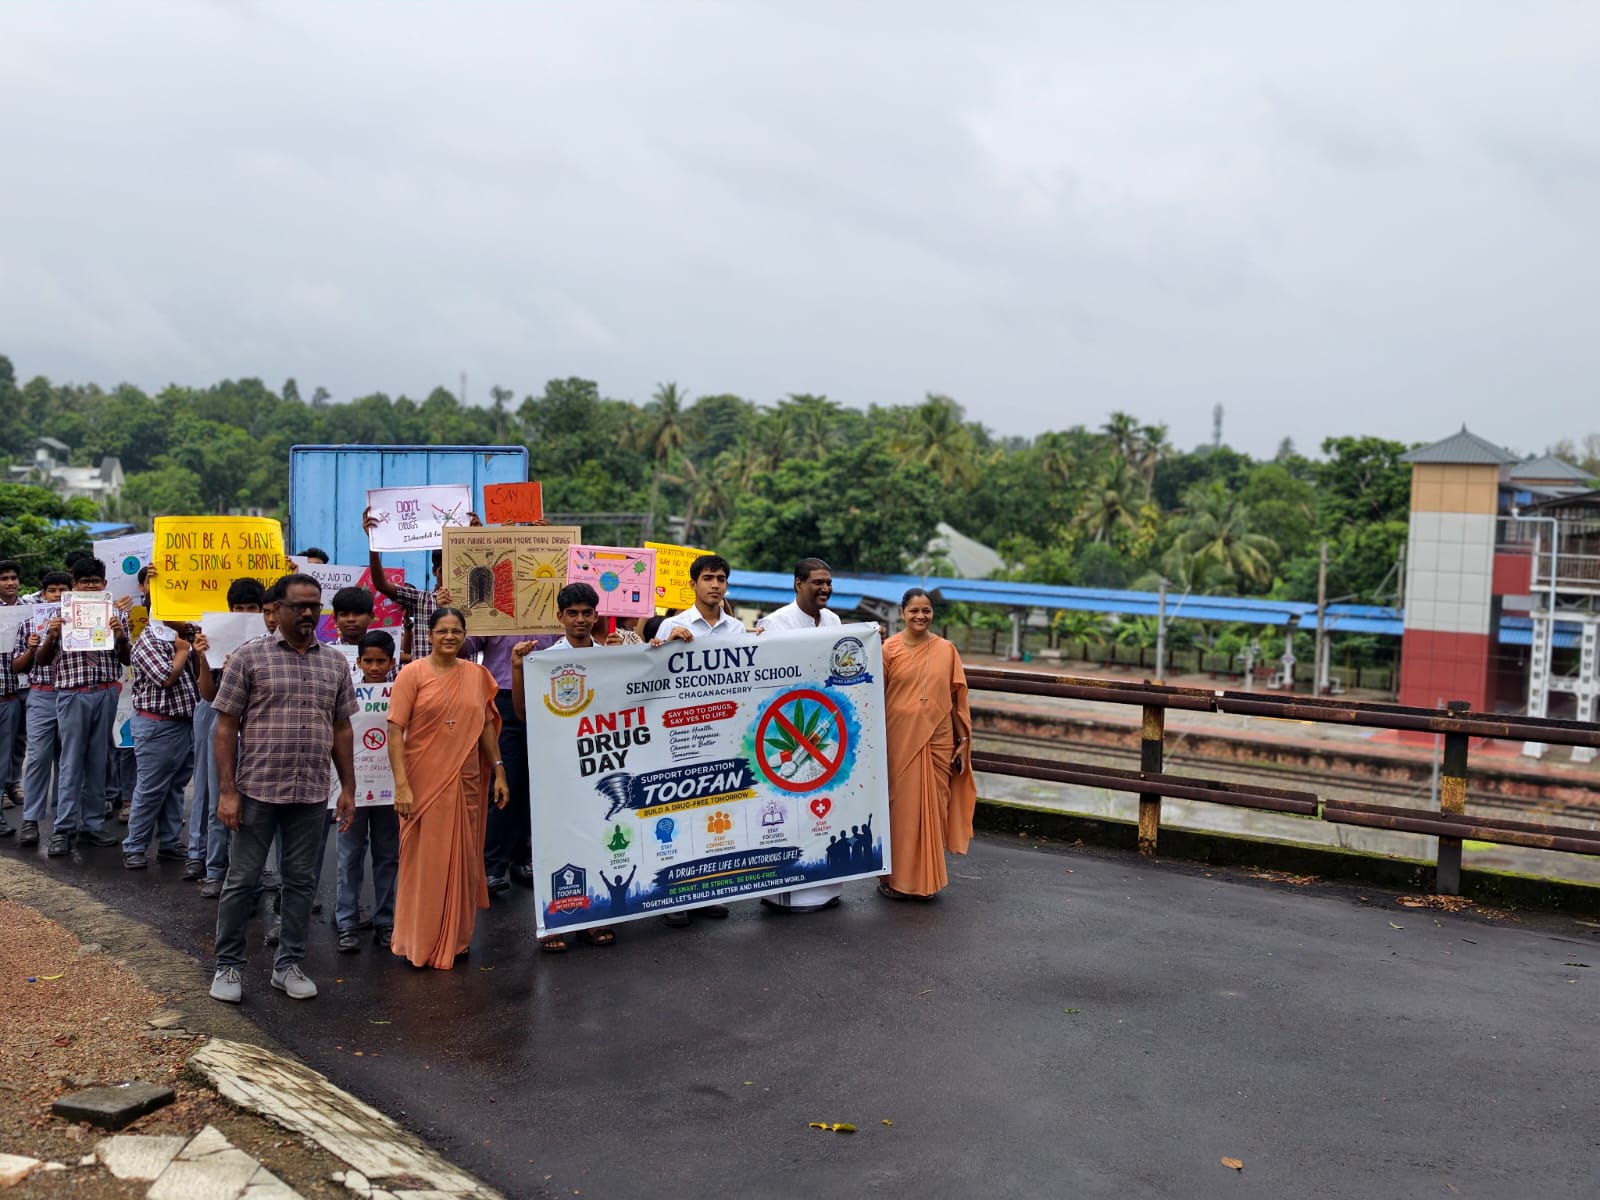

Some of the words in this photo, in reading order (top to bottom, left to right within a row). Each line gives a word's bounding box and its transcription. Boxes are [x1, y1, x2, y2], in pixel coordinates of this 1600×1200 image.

[166, 531, 198, 549] DON'T
[203, 532, 214, 549] BE
[221, 532, 230, 549] A
[238, 532, 275, 549] SLAVE
[165, 554, 180, 571] BE
[189, 554, 232, 572] STRONG
[165, 579, 188, 590] SAY
[201, 580, 218, 590] NO
[328, 572, 340, 582] NO
[341, 574, 352, 582] TO
[668, 646, 758, 673] CLUNY
[626, 679, 670, 695] SENIOR
[675, 670, 751, 689] SECONDARY
[754, 666, 802, 682] SCHOOL
[356, 687, 374, 700] AY
[381, 687, 392, 698] N
[678, 686, 753, 700] CHAGANACHERRY
[365, 702, 388, 712] DRU
[577, 706, 646, 737] ANTI
[577, 726, 650, 758] DRUG
[580, 750, 628, 777] DAY
[641, 770, 682, 784] SUPPORT
[684, 762, 735, 776] OPERATION
[643, 770, 744, 805] TOOFAN
[644, 808, 664, 816] BUILD
[672, 799, 710, 810] DRUG-FREE
[711, 792, 749, 804] TOMORROW
[668, 870, 674, 880] A
[676, 863, 716, 878] DRUG-FREE
[718, 860, 732, 872] LIFE
[734, 859, 740, 868] IS
[741, 858, 746, 866] A
[748, 852, 782, 866] VICTORIOUS
[783, 849, 798, 862] LIFE!
[557, 888, 582, 898] TOOFAN
[676, 894, 692, 903] LET'S
[692, 891, 710, 900] BUILD
[716, 886, 738, 896] BETTER
[740, 884, 752, 892] AND
[754, 878, 784, 890] HEALTHIER
[784, 874, 806, 886] WORLD.
